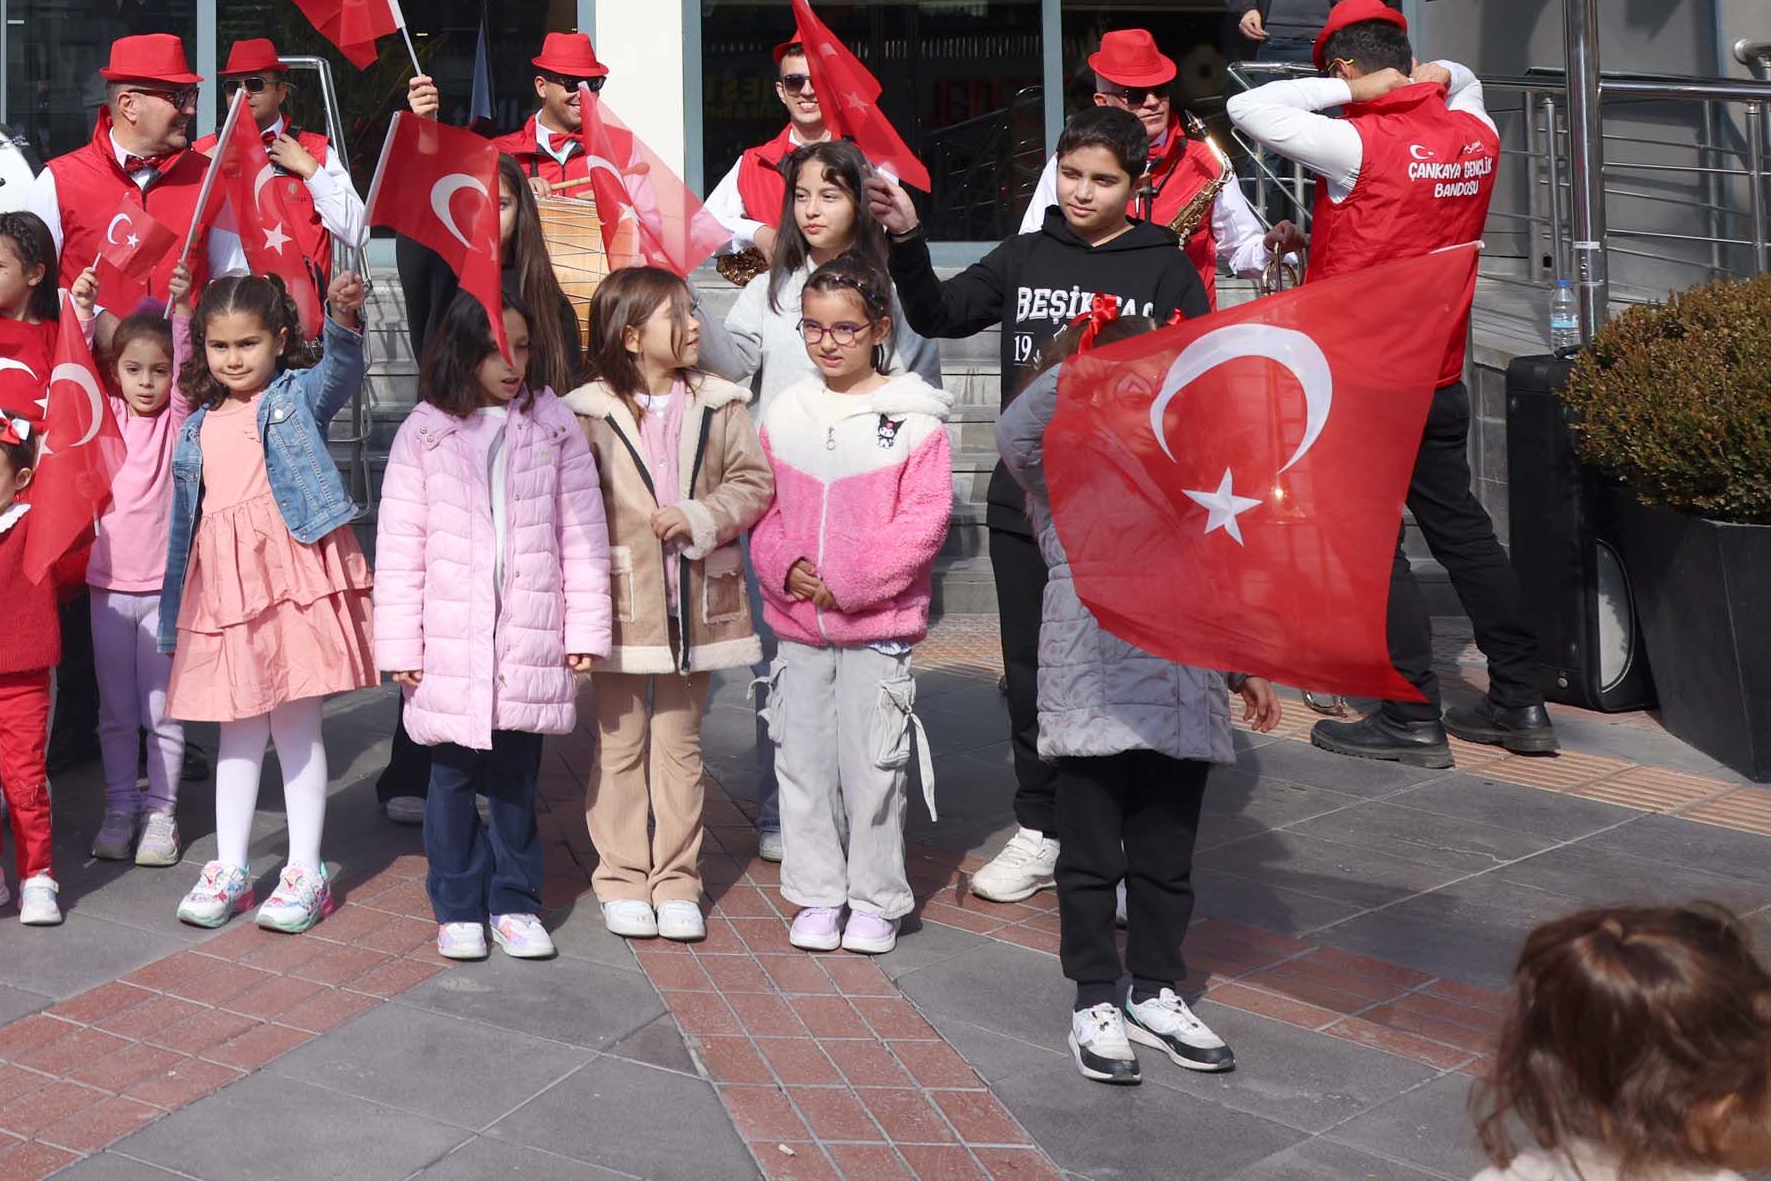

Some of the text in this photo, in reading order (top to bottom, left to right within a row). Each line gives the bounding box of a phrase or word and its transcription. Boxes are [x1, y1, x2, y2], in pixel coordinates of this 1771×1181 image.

[1408, 156, 1493, 182] ÇANKAYA GENÇLİK
[1434, 180, 1479, 198] BANDOSU
[1014, 335, 1033, 362] 19
